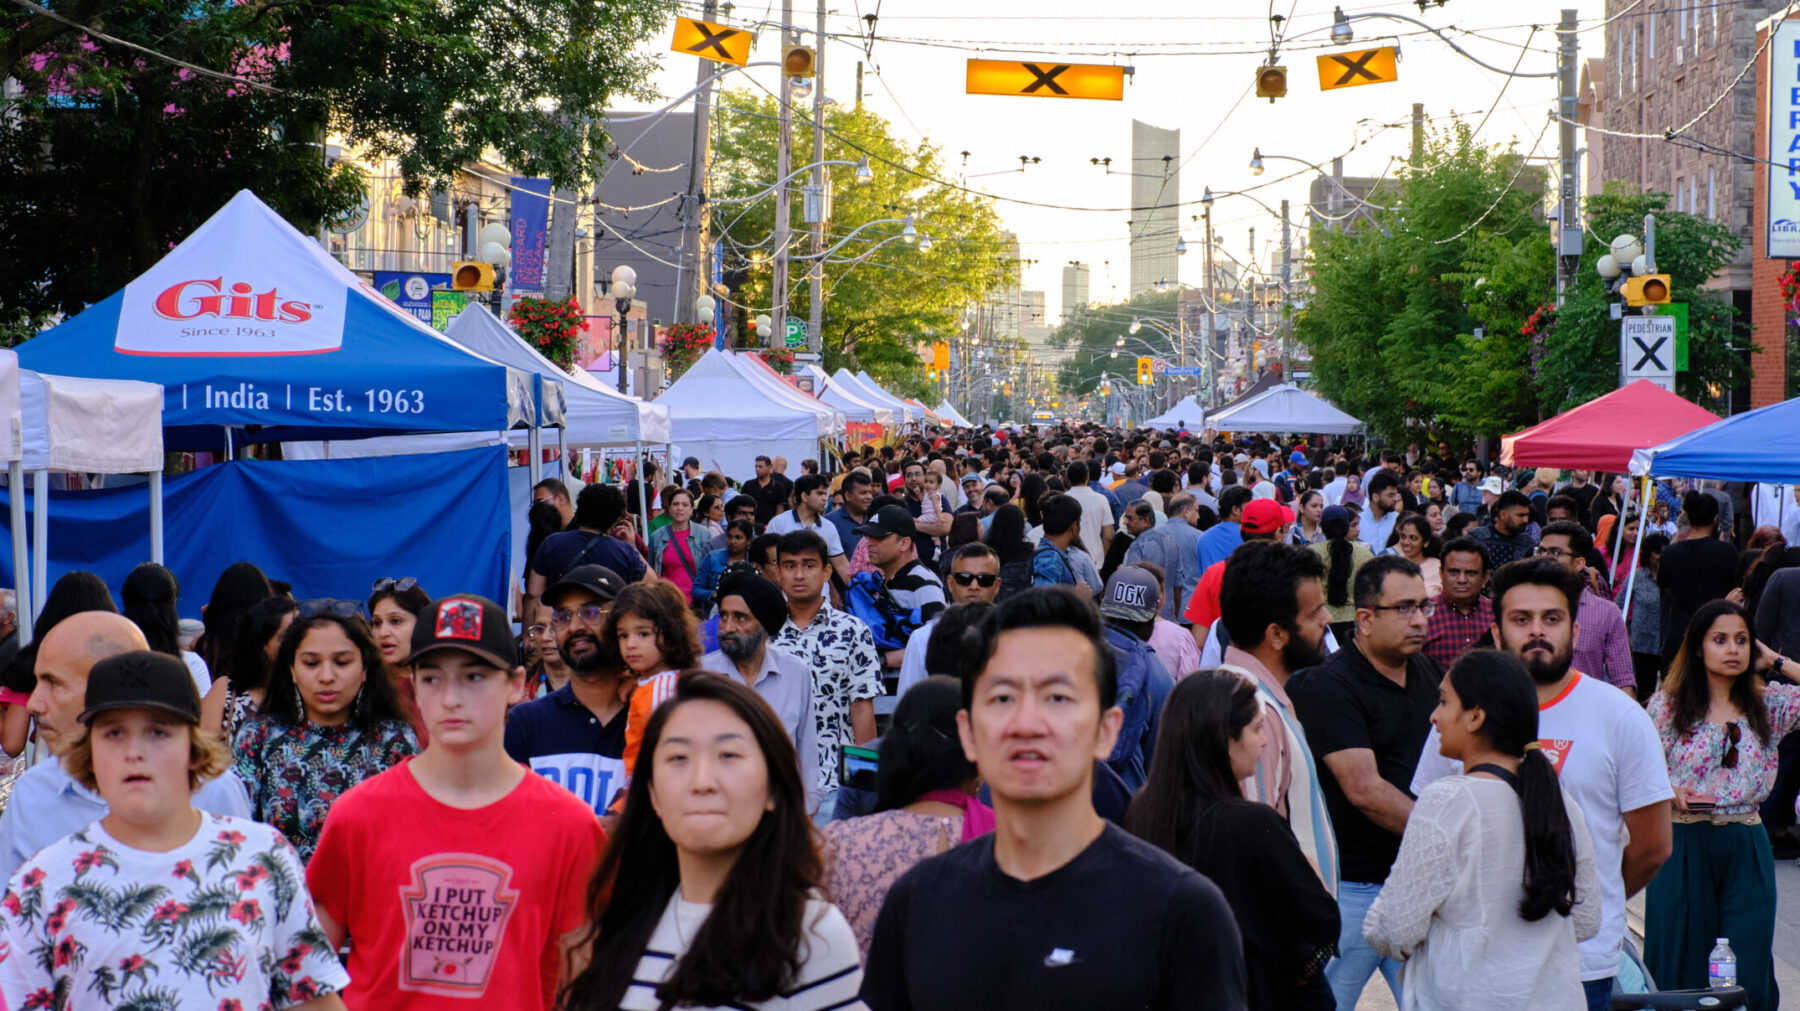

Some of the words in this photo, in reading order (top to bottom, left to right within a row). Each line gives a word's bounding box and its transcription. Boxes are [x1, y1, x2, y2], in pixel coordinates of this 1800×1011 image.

[515, 218, 527, 284] GERRARD
[530, 230, 544, 284] BAZAAR
[152, 276, 313, 324] Gits
[180, 327, 230, 338] Since
[236, 326, 276, 337] 1963
[1629, 324, 1672, 333] PEDESTRIAN
[205, 383, 269, 410] India
[309, 387, 352, 412] Est.
[365, 389, 425, 414] 1963
[1114, 581, 1147, 607] DGK
[434, 887, 439, 902] I
[446, 888, 486, 904] PUT
[416, 903, 503, 922] KETCHUP
[424, 920, 451, 936] ON
[458, 923, 489, 938] MY
[413, 936, 494, 954] KETCHUP
